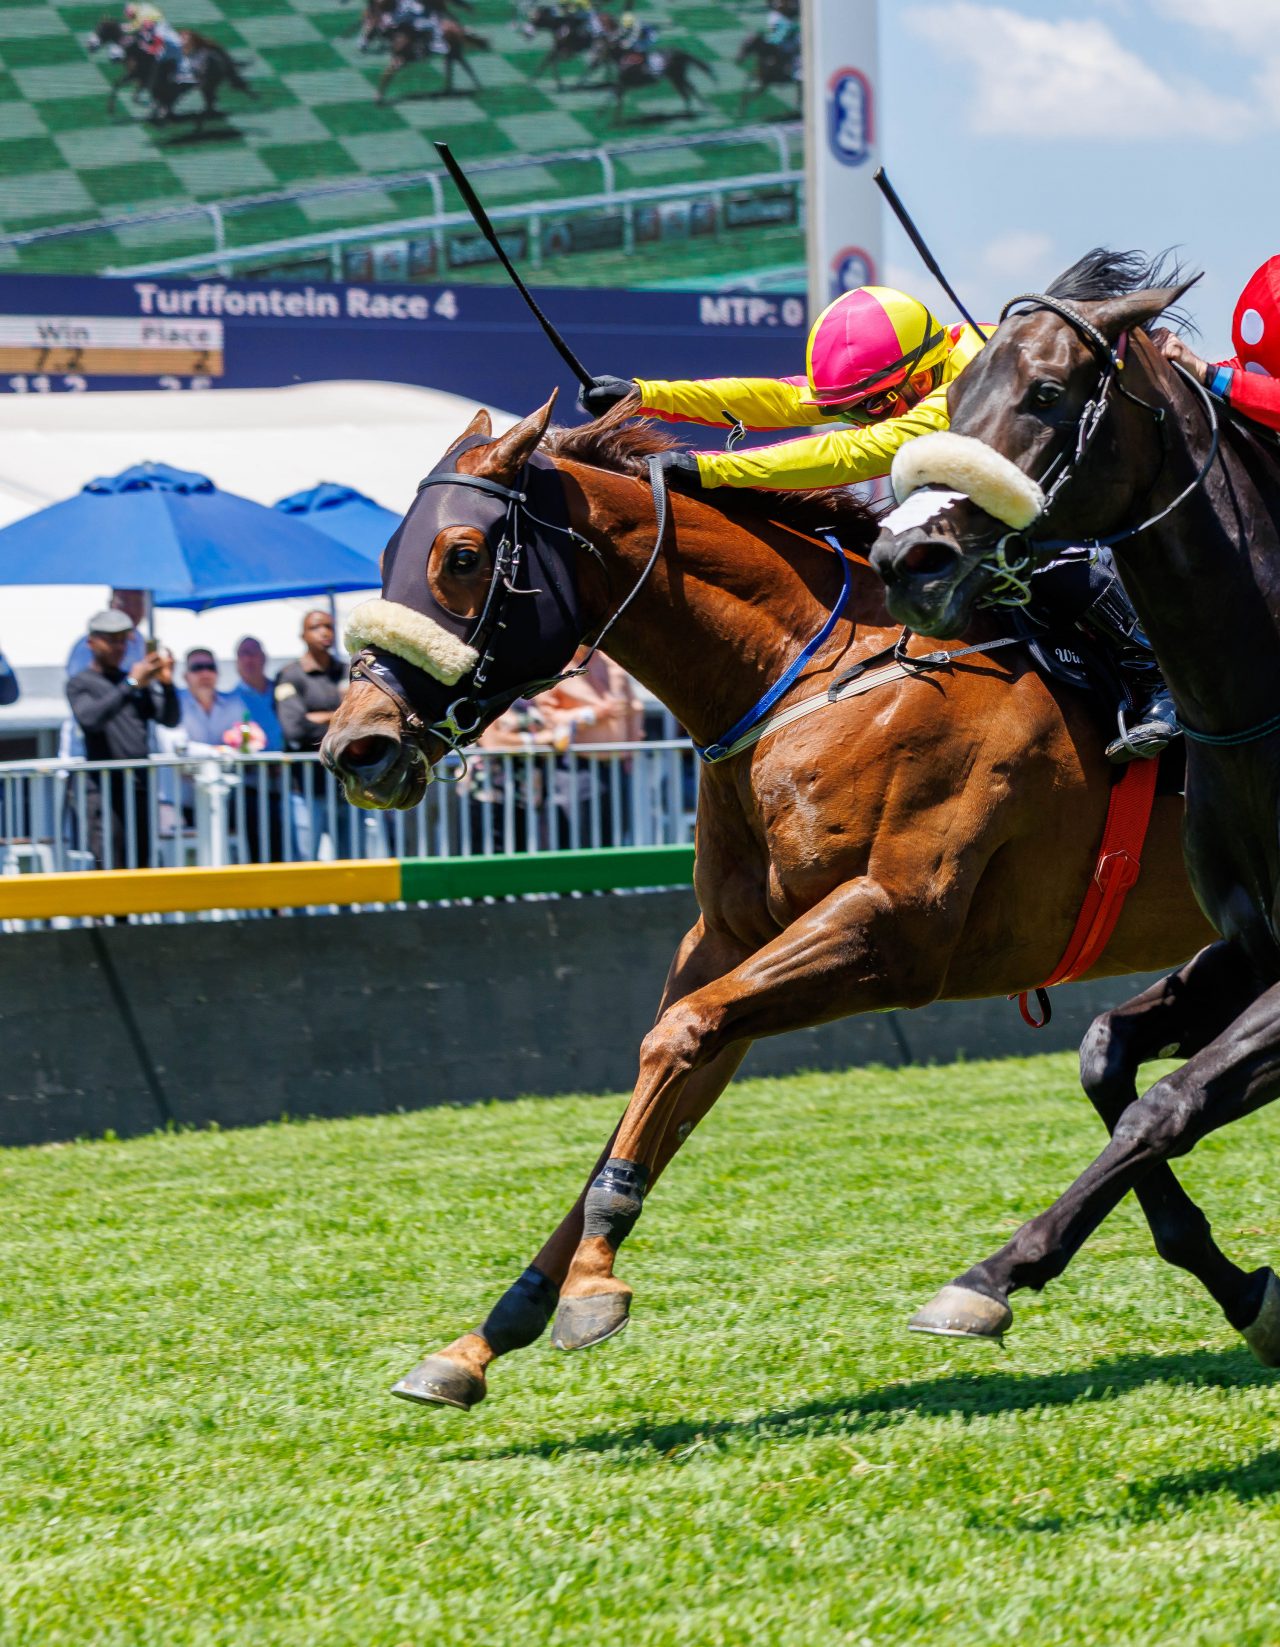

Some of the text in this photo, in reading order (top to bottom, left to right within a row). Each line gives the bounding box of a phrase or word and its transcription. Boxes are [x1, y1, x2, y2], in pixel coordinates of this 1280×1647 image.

[135, 284, 458, 320] Turffontein Race 4
[701, 297, 778, 326] MTP:
[37, 323, 210, 342] Win Place
